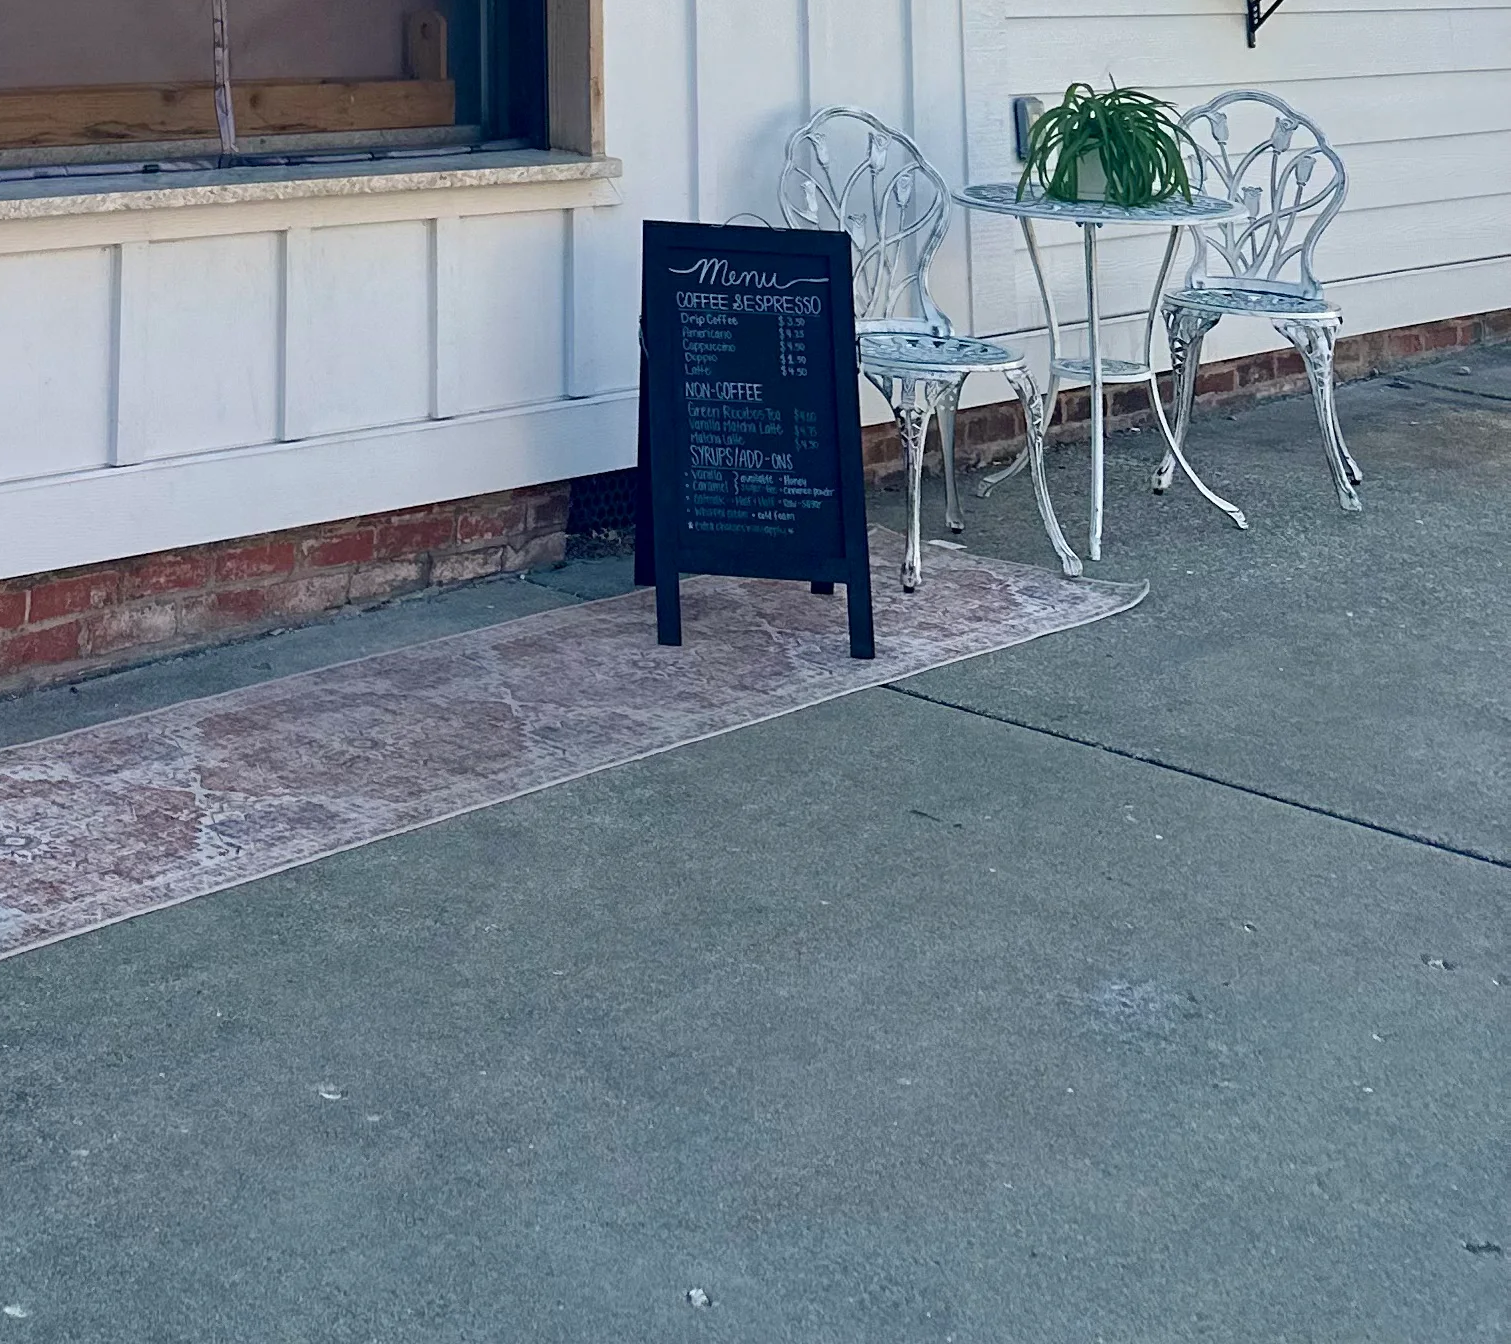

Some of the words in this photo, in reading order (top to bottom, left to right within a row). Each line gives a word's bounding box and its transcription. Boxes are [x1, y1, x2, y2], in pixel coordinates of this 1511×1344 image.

[668, 258, 830, 290] Menu
[675, 291, 729, 310] COFFEE
[743, 294, 822, 315] ESPRESSO
[680, 312, 705, 326] Drip
[706, 313, 739, 326] Coffee
[685, 381, 763, 401] NON-COFFEE
